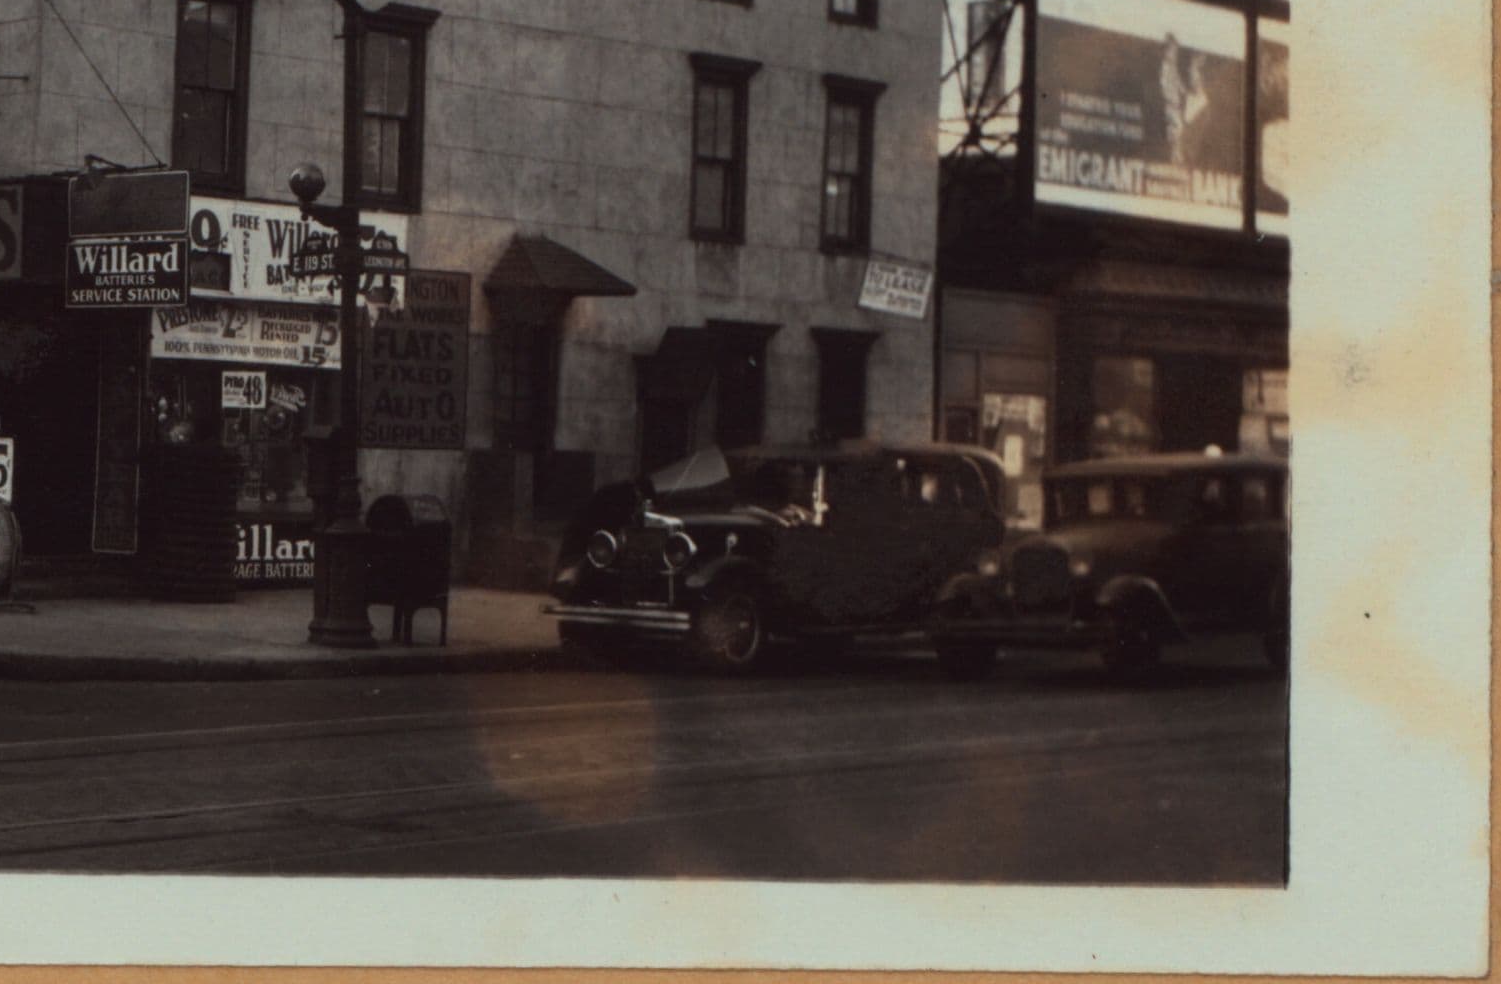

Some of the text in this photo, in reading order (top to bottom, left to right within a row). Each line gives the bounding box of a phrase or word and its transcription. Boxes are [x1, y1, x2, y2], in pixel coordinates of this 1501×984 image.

[1039, 144, 1145, 196] EMIGRANT
[1192, 168, 1242, 208] BANK
[232, 213, 260, 231] FREE
[74, 242, 180, 274] Willard
[305, 255, 318, 271] 119
[95, 274, 156, 286] BATTERIES
[71, 287, 180, 302] SERVICE STATION
[283, 347, 298, 360] OIL
[373, 327, 453, 362] FLATS
[372, 363, 452, 384] FIXED
[243, 375, 262, 405] 48
[371, 389, 456, 421] AUTO
[364, 421, 461, 444] SUPPLIES
[236, 524, 315, 560] illar
[265, 562, 315, 578] BATTERI
